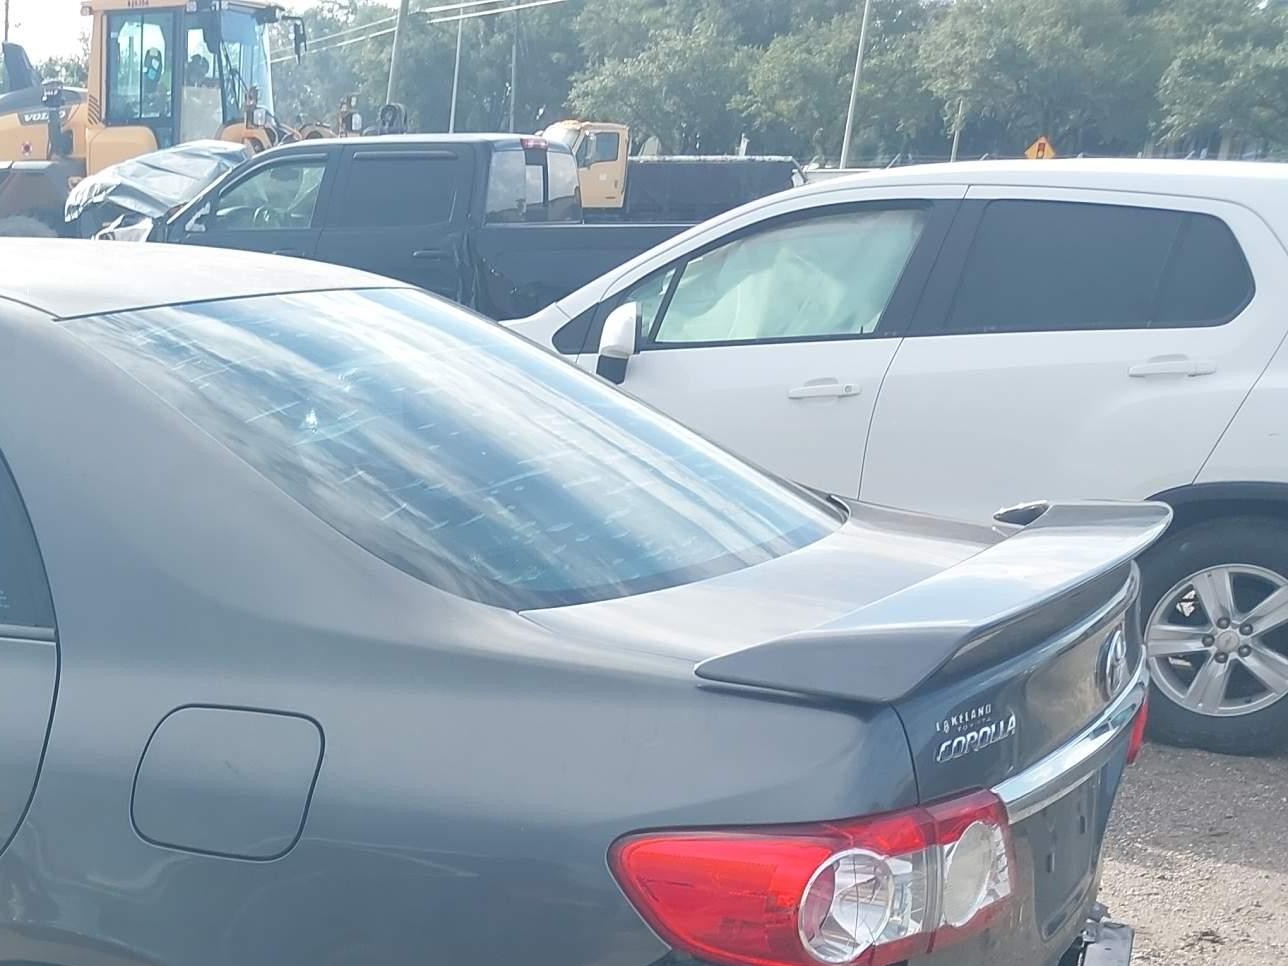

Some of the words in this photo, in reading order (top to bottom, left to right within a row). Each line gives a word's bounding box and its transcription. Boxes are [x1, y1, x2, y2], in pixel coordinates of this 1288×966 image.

[24, 110, 66, 122] VOLO
[936, 703, 992, 734] LAKELAND
[936, 711, 1017, 764] COROLLA
